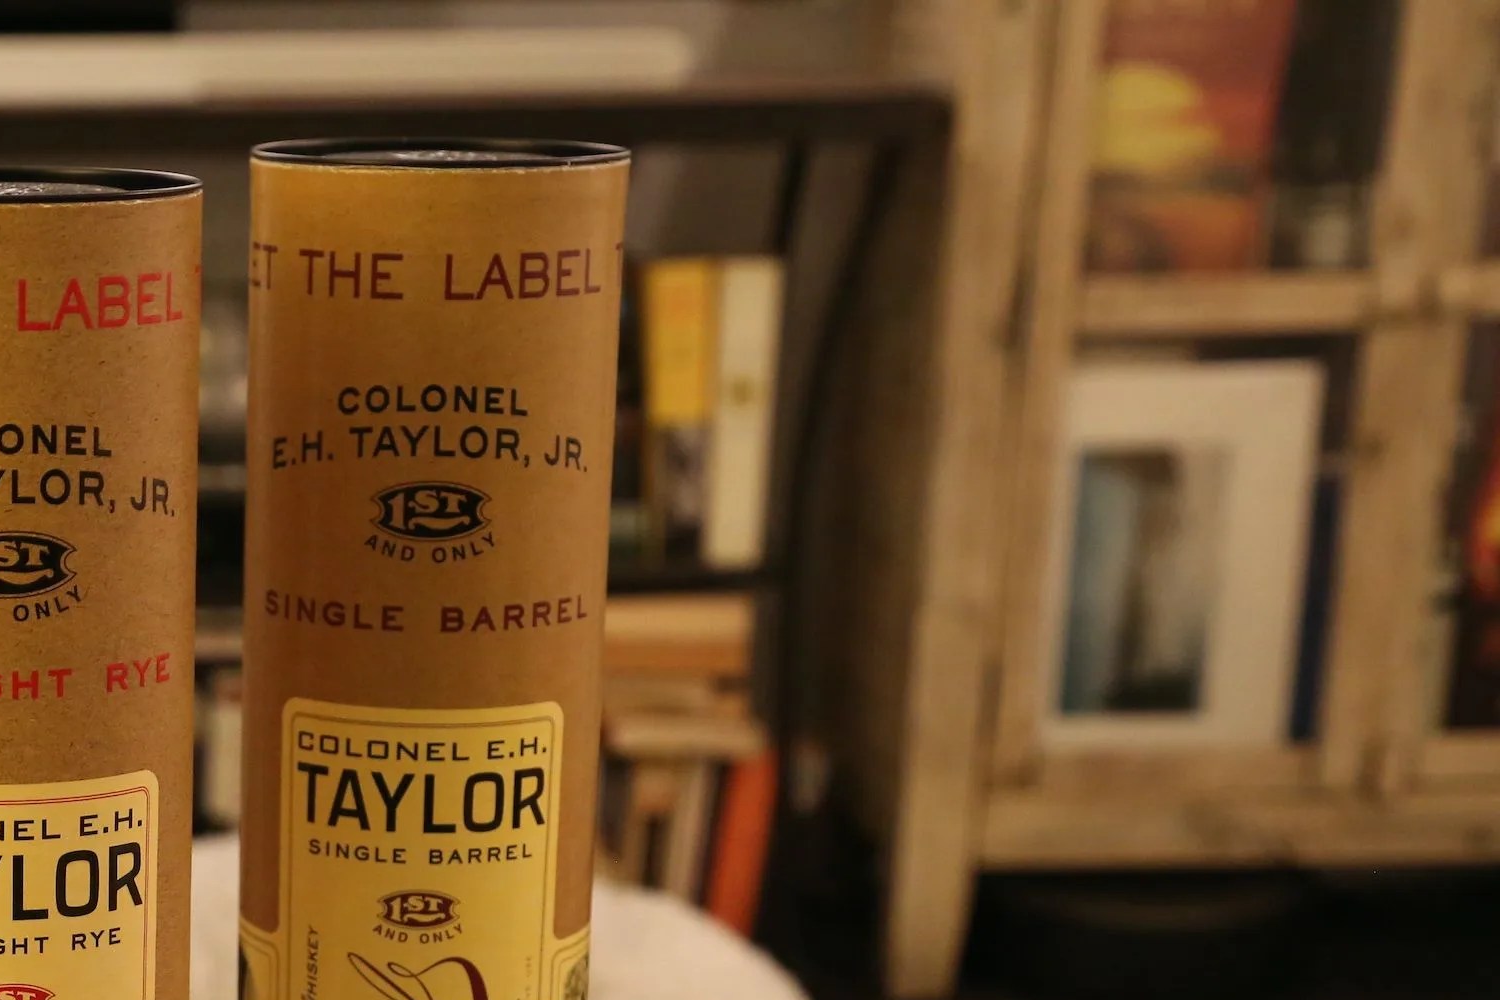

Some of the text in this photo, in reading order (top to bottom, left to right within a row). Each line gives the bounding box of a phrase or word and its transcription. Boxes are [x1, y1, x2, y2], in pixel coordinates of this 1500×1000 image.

[299, 249, 404, 300] THE
[445, 247, 601, 301] LABEL
[17, 269, 183, 332] LABEL
[338, 384, 528, 417] COLONEL
[272, 425, 588, 473] E.H. TAYLOR, JR.
[389, 489, 469, 531] 1ST
[364, 530, 497, 563] AND ONLY
[12, 584, 82, 622] ONLY
[265, 589, 588, 633] SINGLE BARREL
[105, 652, 171, 693] RYE
[297, 730, 548, 762] COLONEL E.H.
[297, 761, 546, 834] TAYLOR
[78, 808, 143, 838] E.H.
[308, 838, 533, 866] SINGLE BARREL
[71, 926, 122, 951] RYE
[372, 923, 464, 945] AND ONLY
